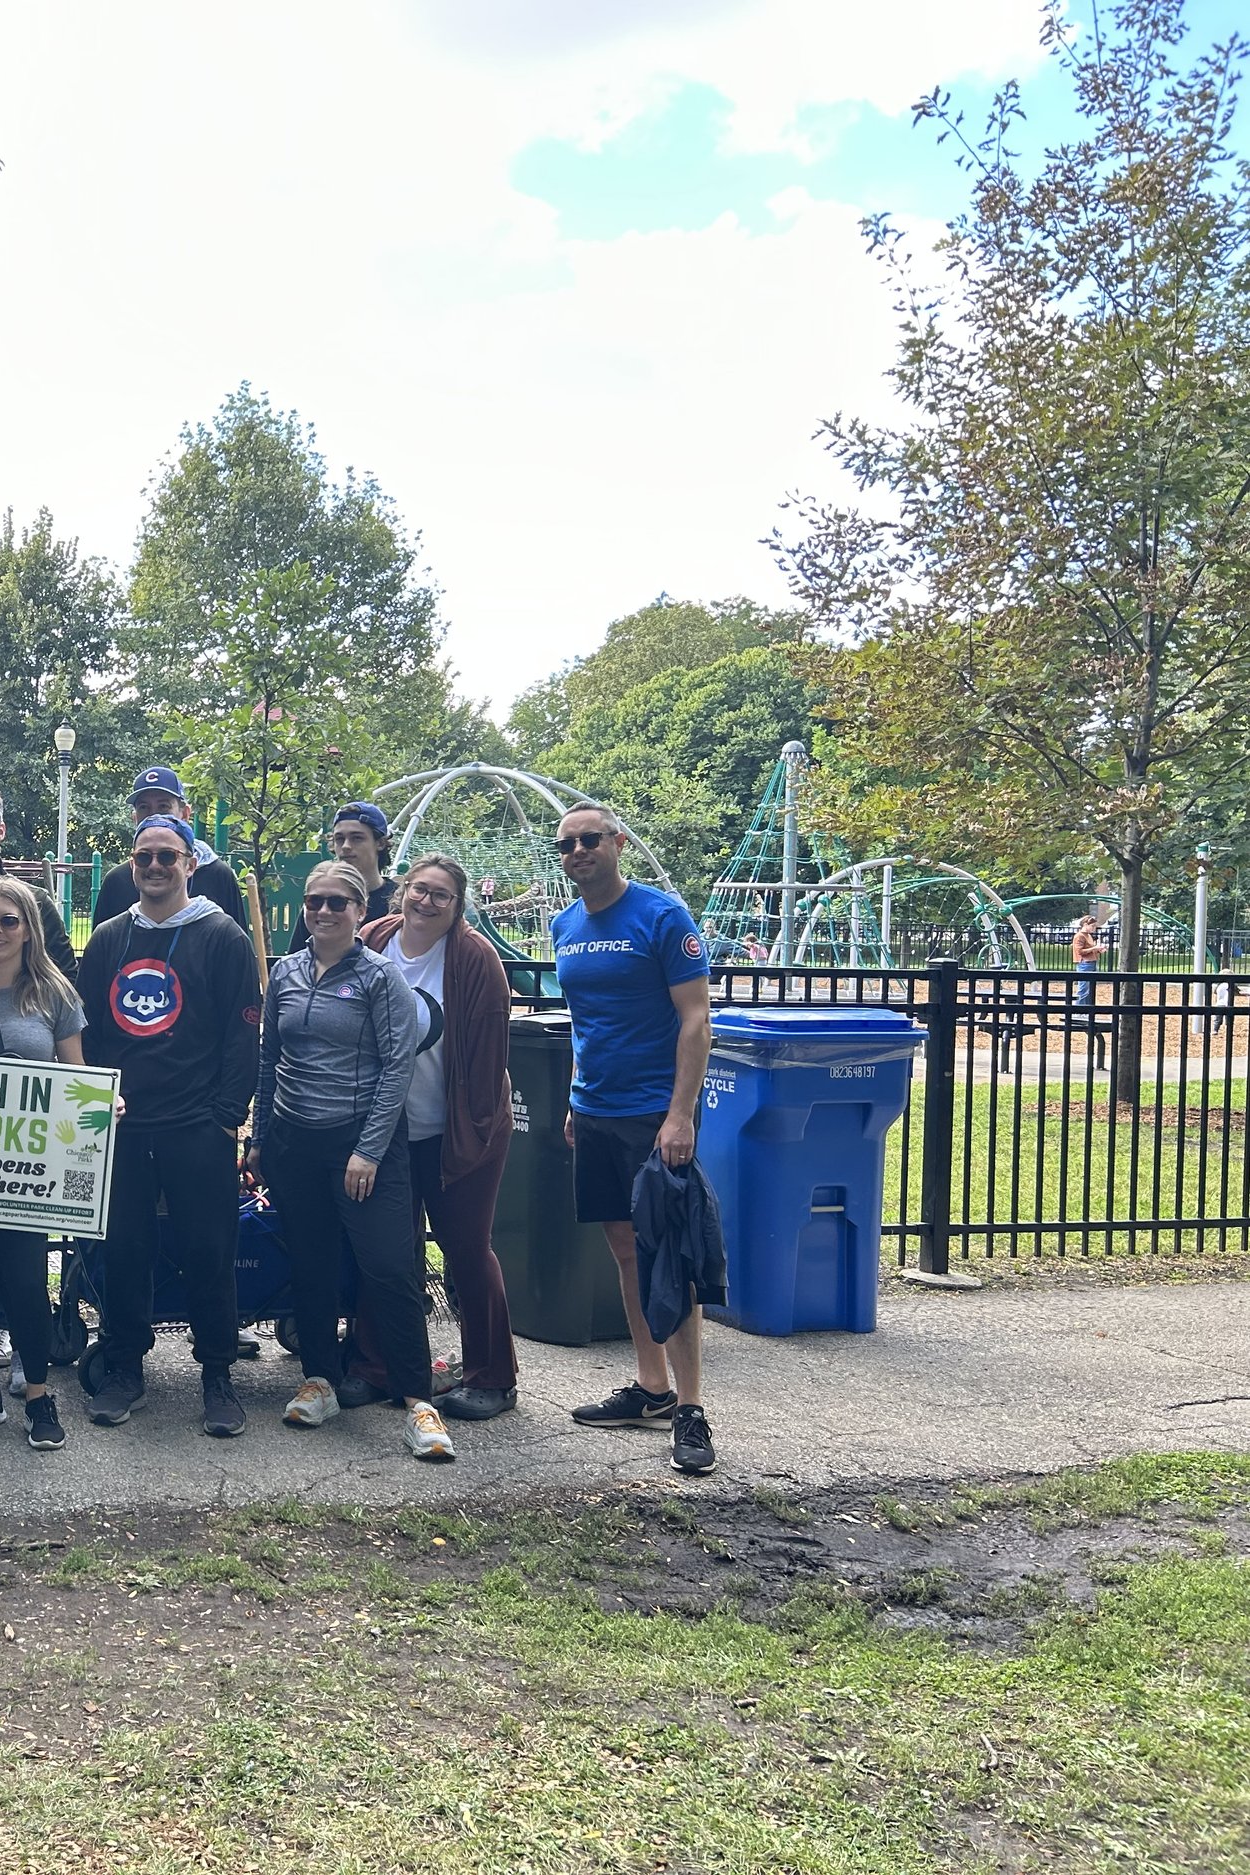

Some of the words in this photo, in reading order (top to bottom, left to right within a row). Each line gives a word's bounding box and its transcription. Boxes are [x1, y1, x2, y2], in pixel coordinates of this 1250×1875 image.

[145, 771, 159, 783] C
[557, 942, 587, 957] FRONT
[587, 940, 634, 953] OFFICE.
[830, 1066, 876, 1078] 0823648197
[703, 1077, 735, 1093] CYCLE
[19, 1075, 52, 1113] IN
[0, 1201, 30, 1209] VOLUNTEER
